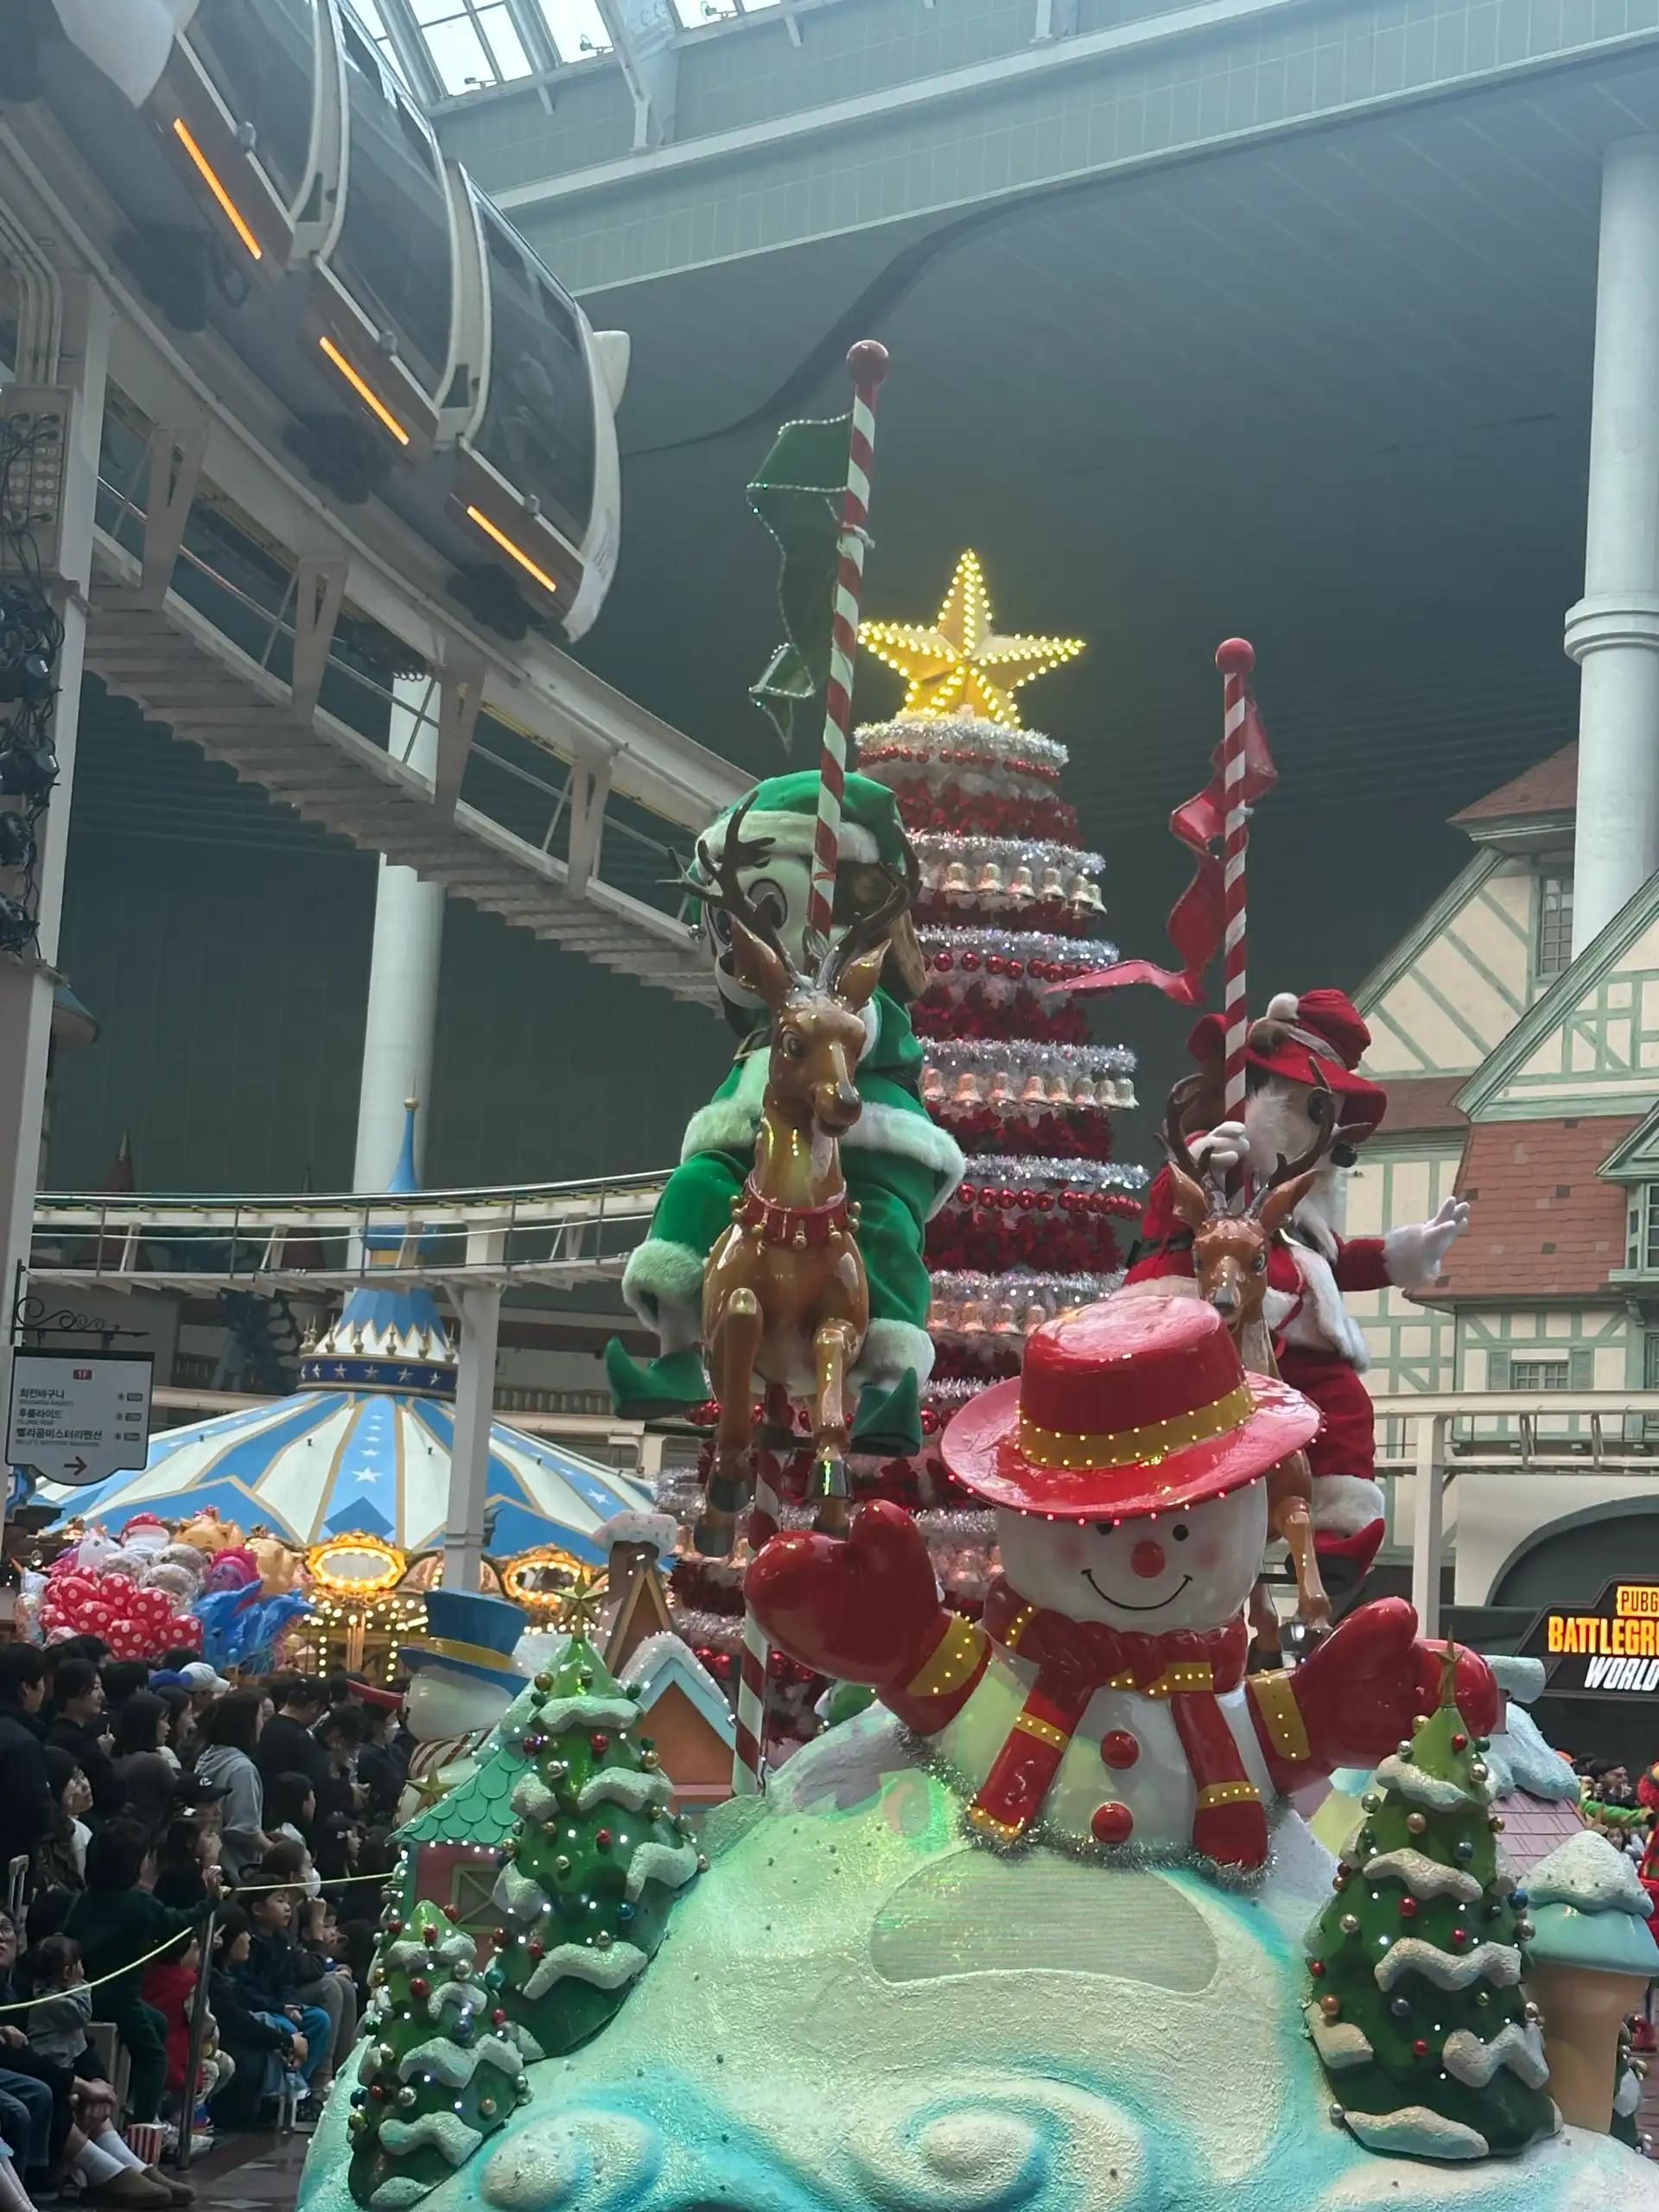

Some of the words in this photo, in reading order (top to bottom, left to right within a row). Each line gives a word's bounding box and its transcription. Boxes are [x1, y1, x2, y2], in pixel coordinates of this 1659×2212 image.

[1621, 1590, 1659, 1612] PUBG
[1548, 1616, 1659, 1656] BATTLEGR
[1584, 1656, 1659, 1691] WORLD
